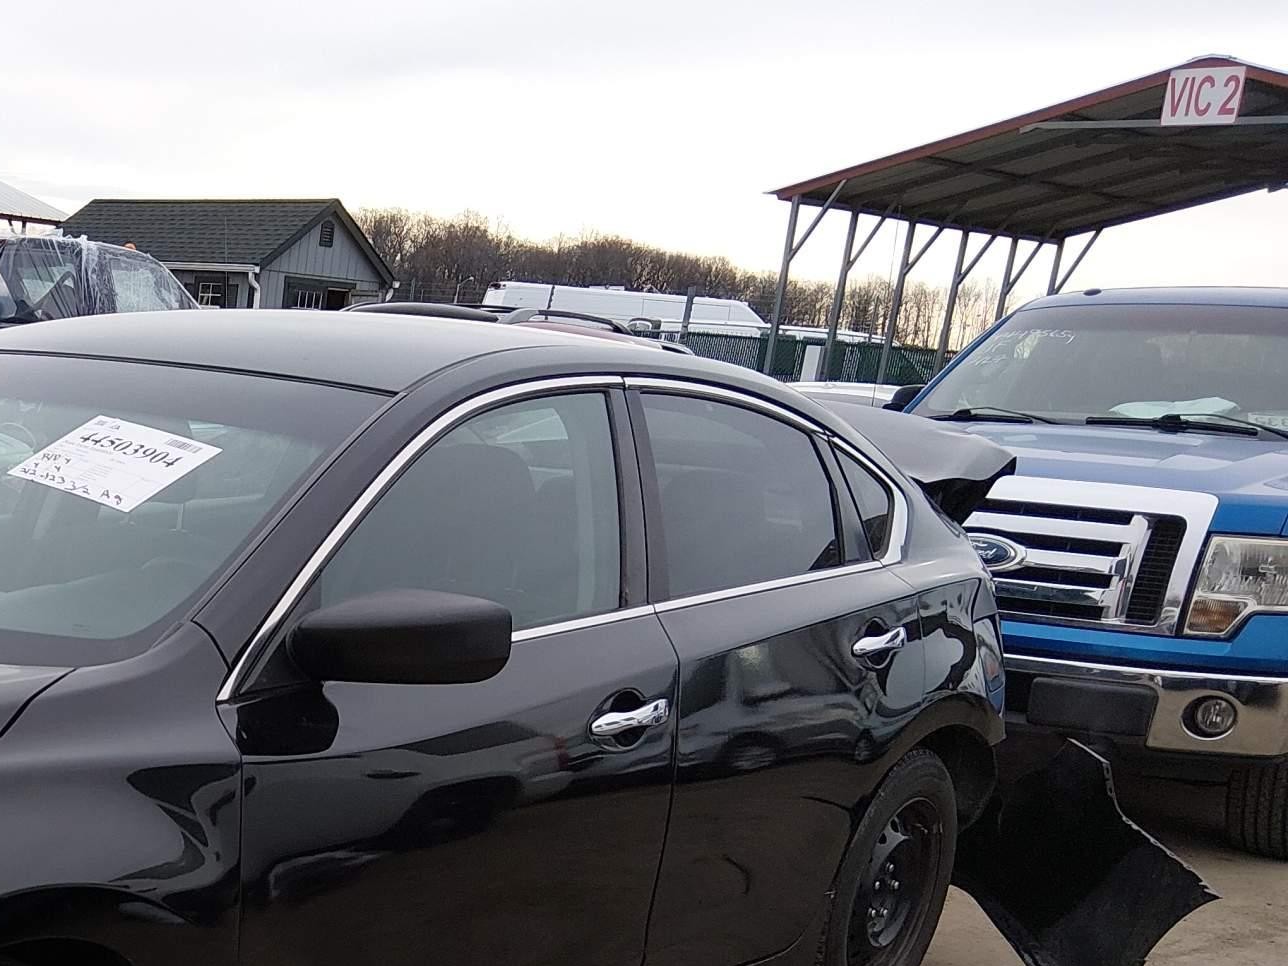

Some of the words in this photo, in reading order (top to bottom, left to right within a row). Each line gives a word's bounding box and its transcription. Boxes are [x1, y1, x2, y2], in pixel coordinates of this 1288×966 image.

[1170, 75, 1215, 117] VIC
[1217, 75, 1241, 116] 2
[79, 432, 184, 468] 44503904
